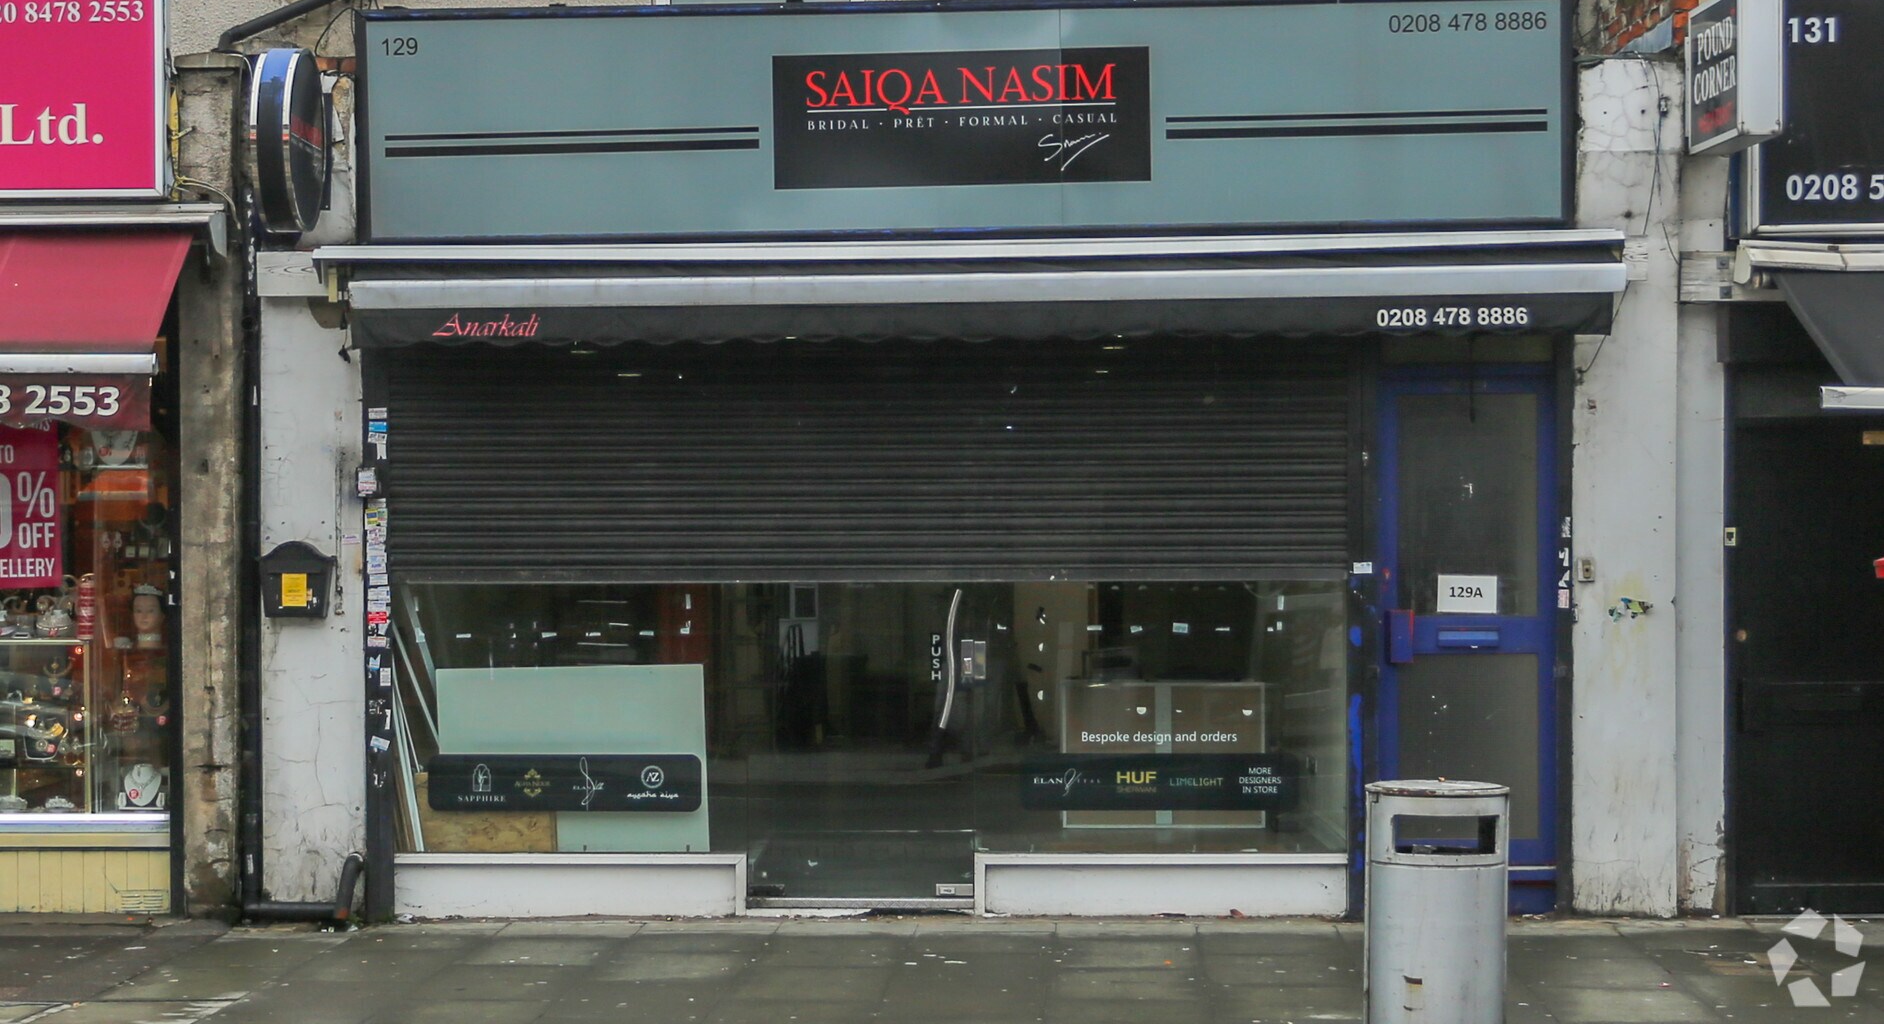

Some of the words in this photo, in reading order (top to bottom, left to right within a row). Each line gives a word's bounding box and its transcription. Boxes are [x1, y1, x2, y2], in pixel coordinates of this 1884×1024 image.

[0, 1, 17, 23] 0
[24, 1, 81, 23] 8478
[88, 0, 144, 22] 2553
[1389, 15, 1440, 33] 0208
[1447, 14, 1487, 31] 478
[1495, 12, 1547, 30] 8886
[1788, 18, 1836, 43] 131
[381, 37, 418, 56] 129
[1697, 16, 1733, 65] POUND
[805, 68, 947, 115] SAIQA
[957, 63, 1116, 104] NASIM
[1694, 55, 1736, 105] CORNER
[0, 103, 104, 145] Ltd.
[807, 119, 869, 131] BRIDAL
[959, 114, 1028, 127] FORMAL
[1052, 112, 1117, 126] CASUAL
[1786, 174, 1858, 200] 0208
[432, 312, 541, 337] Anarkali
[1376, 308, 1427, 326] 0208
[1433, 307, 1470, 325] 478
[1477, 306, 1528, 325] 8886
[24, 384, 120, 416] 2553
[18, 522, 55, 549] OFF
[0, 558, 55, 578] ELLERY
[1449, 586, 1483, 598] 129A
[931, 634, 942, 681] PUSH
[1081, 730, 1130, 744] Bespoke
[1133, 730, 1171, 745] design
[1175, 731, 1197, 742] and
[1201, 730, 1238, 742] orders
[1116, 771, 1157, 784] HUF
[1248, 767, 1272, 775] MORE
[1169, 778, 1223, 786] LIMELIGHT
[1253, 786, 1278, 794] STORE
[457, 794, 507, 803] SAPPHIRE
